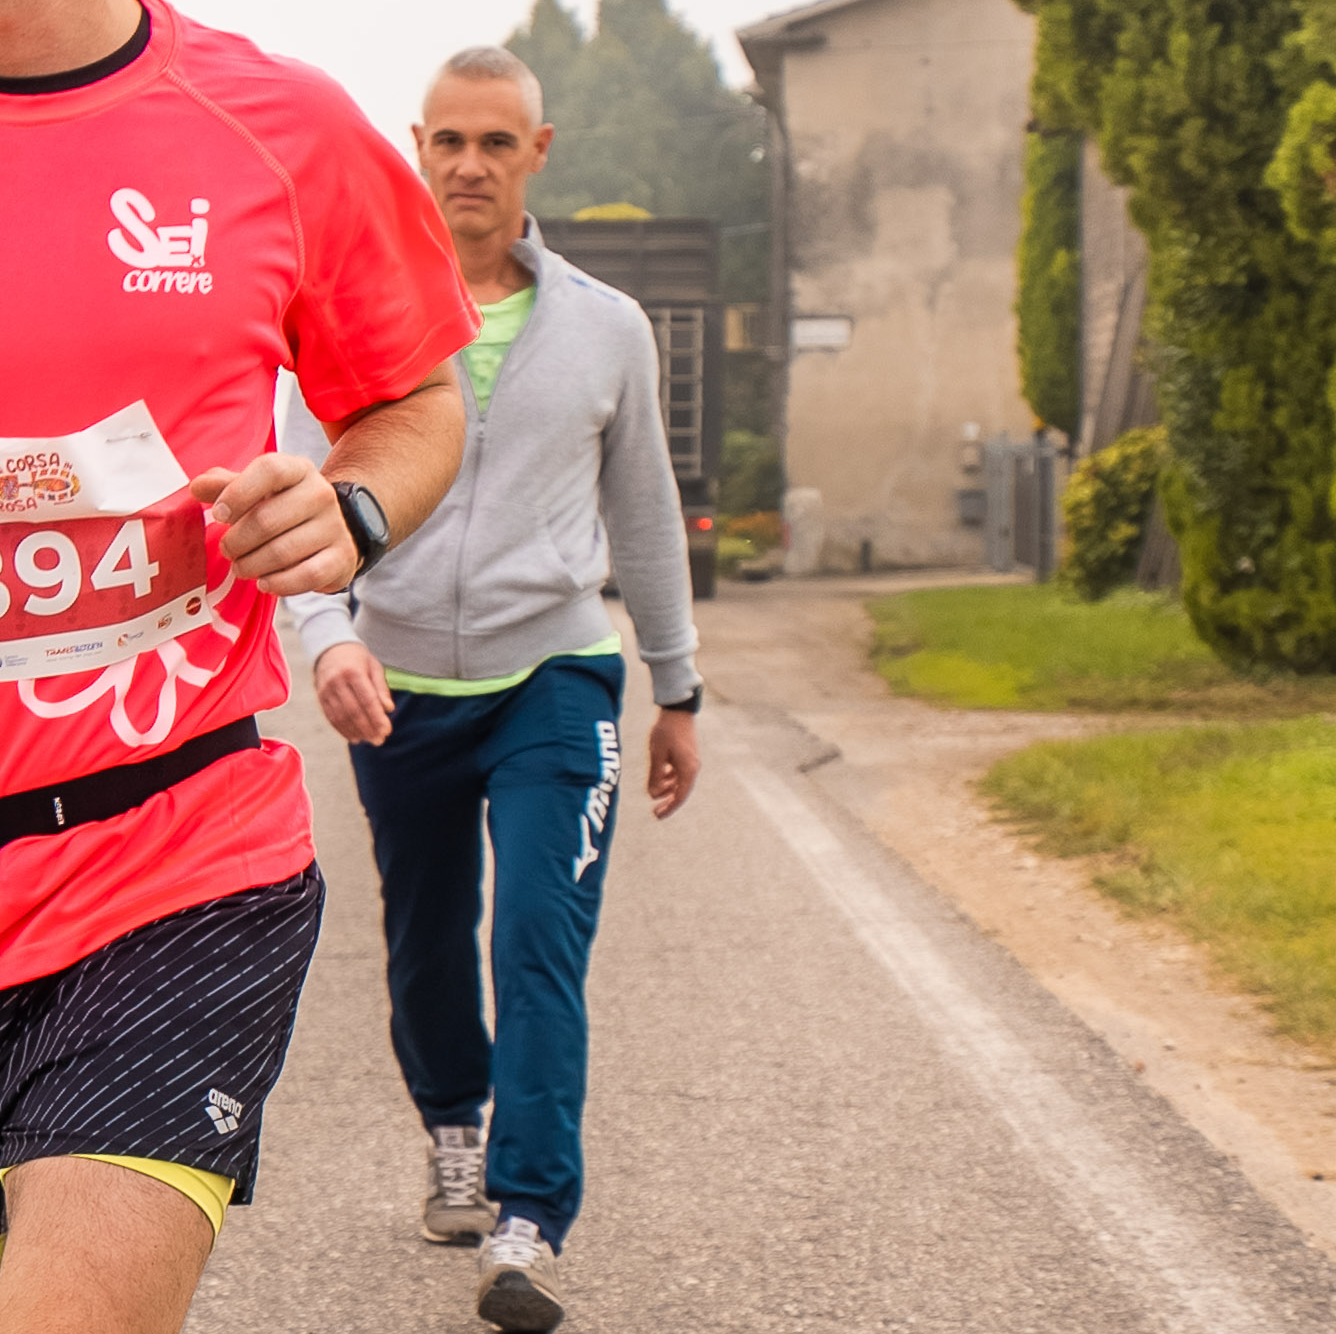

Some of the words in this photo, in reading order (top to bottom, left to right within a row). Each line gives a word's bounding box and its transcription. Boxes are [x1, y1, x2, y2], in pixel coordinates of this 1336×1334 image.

[122, 269, 214, 295] correre
[6, 452, 61, 473] CORSA
[208, 1087, 244, 1120] arena
